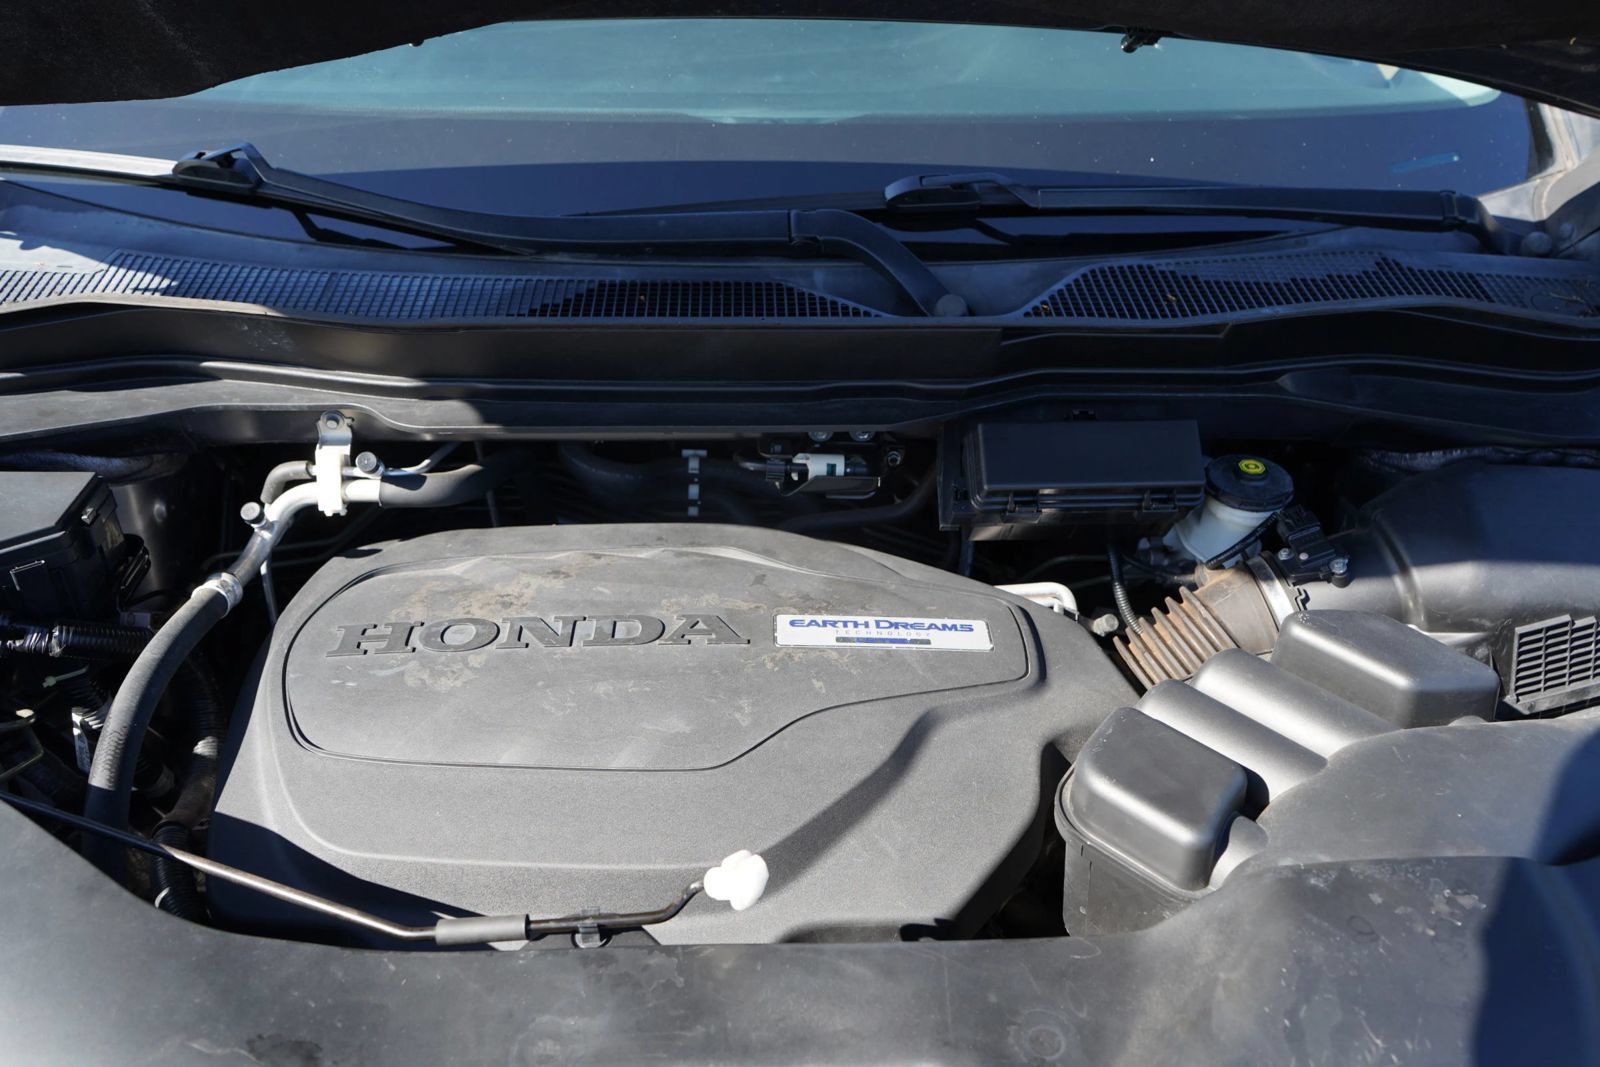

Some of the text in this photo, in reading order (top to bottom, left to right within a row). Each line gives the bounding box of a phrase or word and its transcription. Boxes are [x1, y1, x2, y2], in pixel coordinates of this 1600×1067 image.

[327, 615, 751, 657] HONDA
[788, 619, 974, 632] EARTH DREAMS
